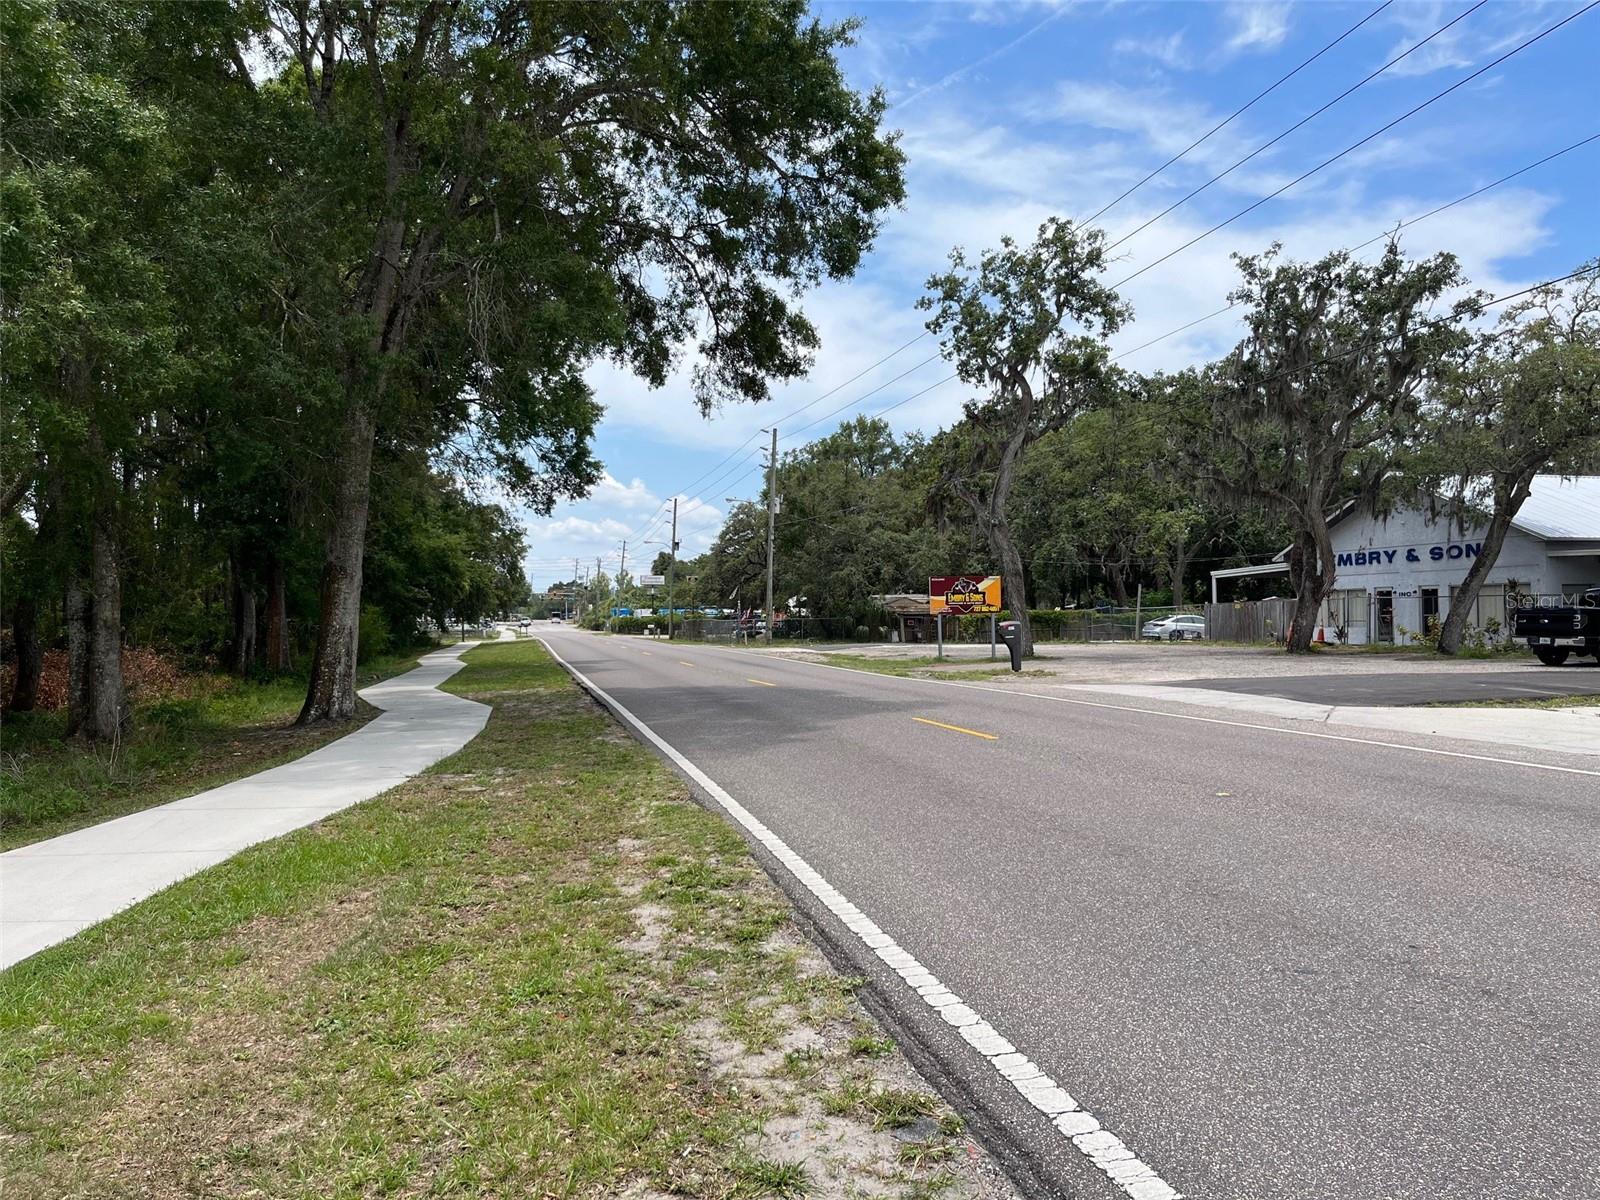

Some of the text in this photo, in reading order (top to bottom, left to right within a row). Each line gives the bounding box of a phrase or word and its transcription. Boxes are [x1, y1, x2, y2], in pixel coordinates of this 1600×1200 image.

[1337, 543, 1482, 567] MBRY & SON
